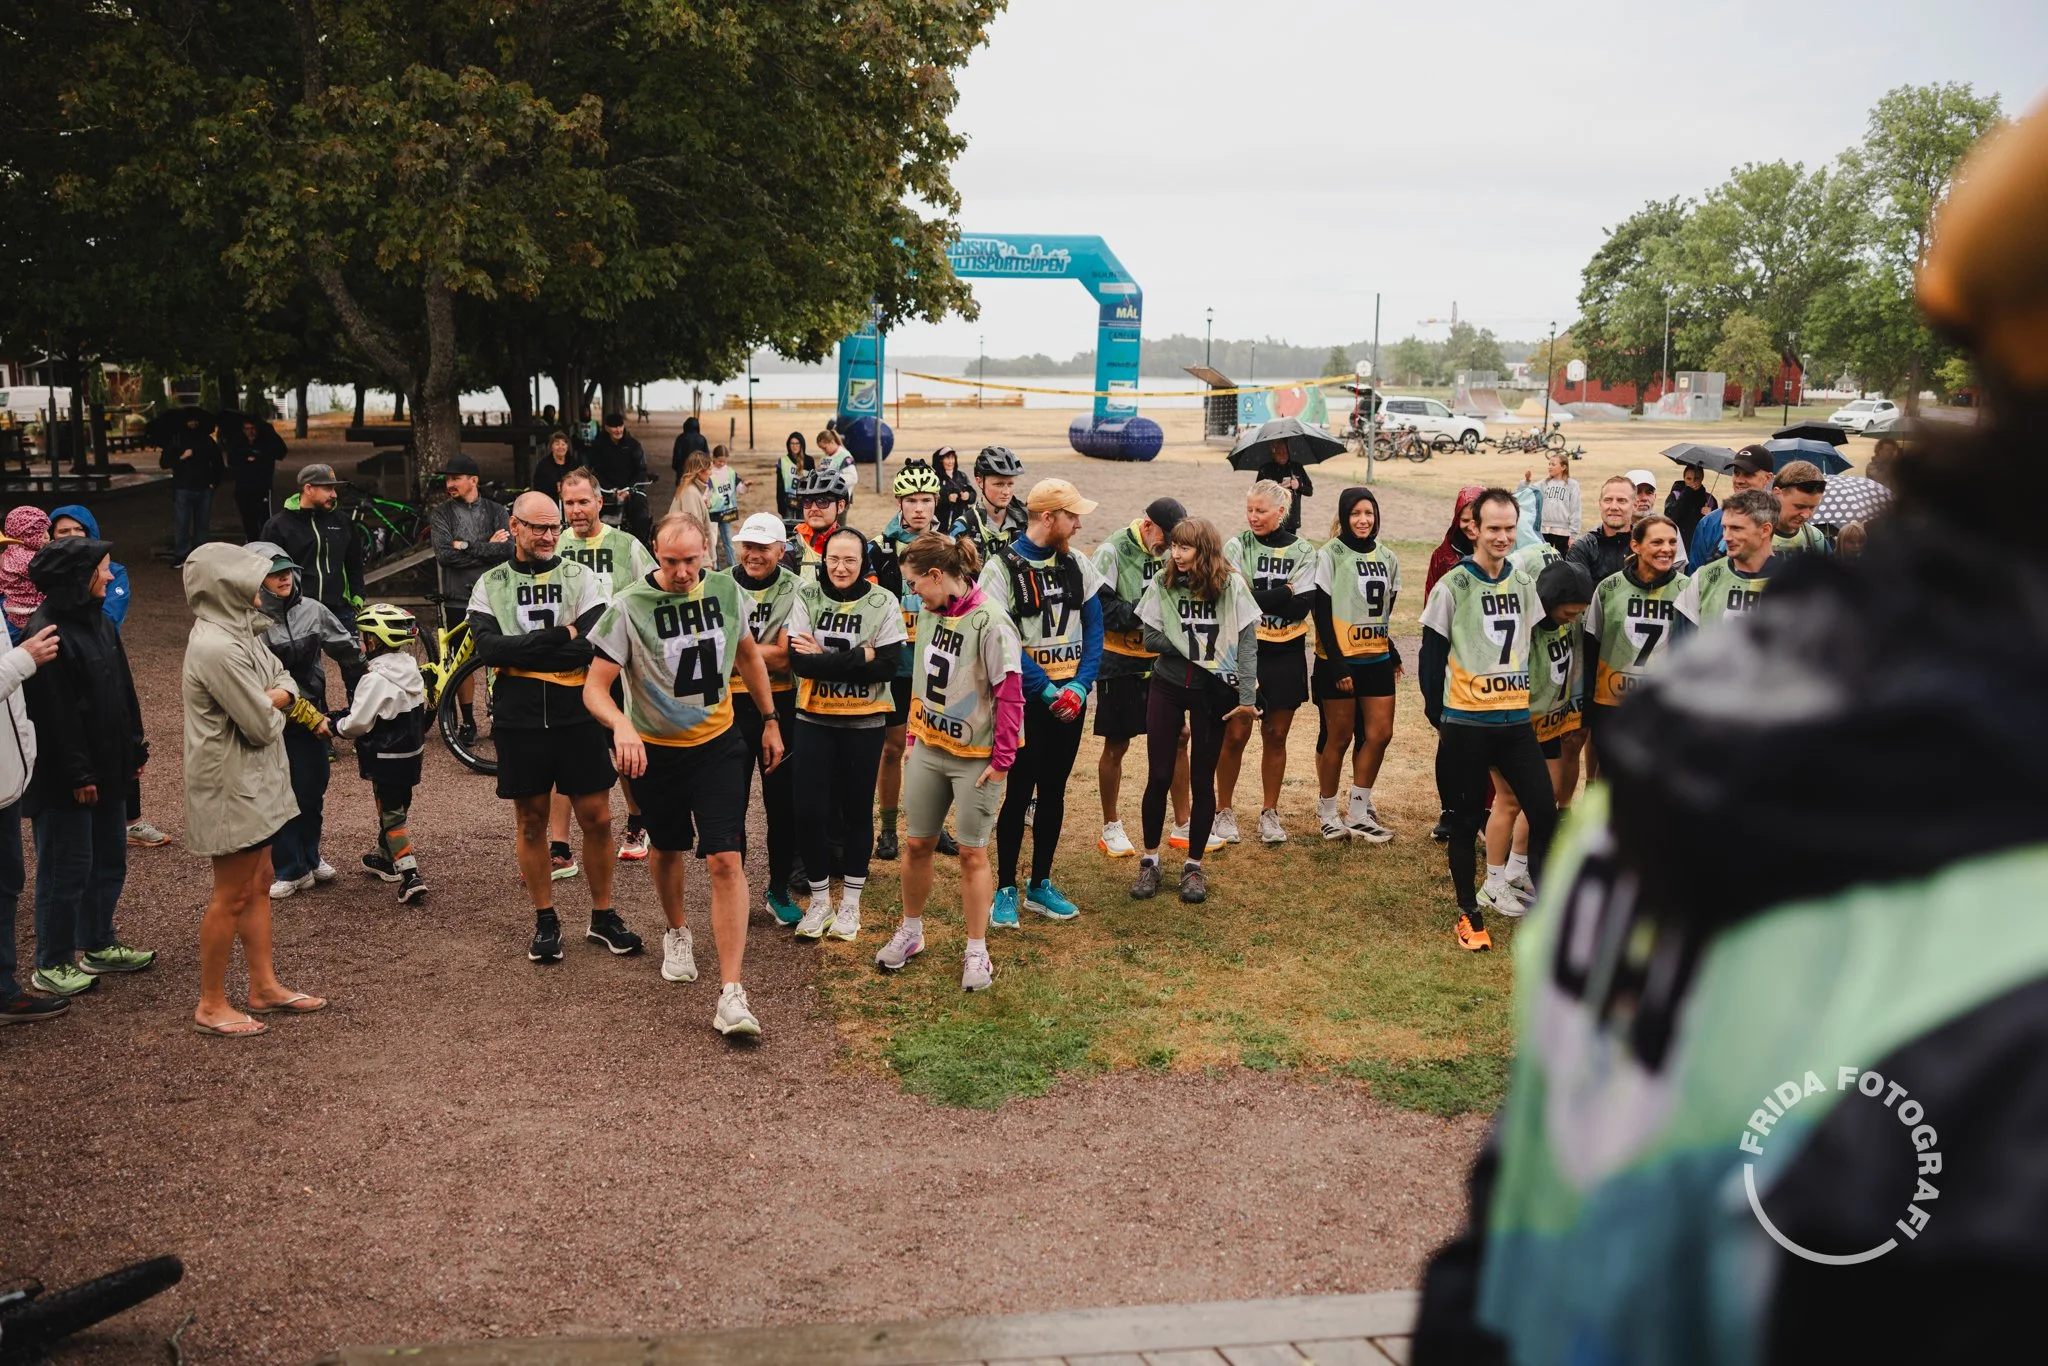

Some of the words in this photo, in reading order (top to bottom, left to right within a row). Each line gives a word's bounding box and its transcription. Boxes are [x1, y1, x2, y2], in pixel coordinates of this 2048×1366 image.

[1116, 305, 1138, 319] MÅL
[723, 494, 730, 506] 3
[1545, 486, 1566, 501] SOHO
[1257, 553, 1295, 575] ÖAR
[1356, 558, 1388, 577] ÖAR
[517, 582, 563, 606] ÖAR
[1178, 595, 1217, 619] ÖAR
[1366, 581, 1386, 617] 9
[1481, 591, 1521, 616] ÖAR
[1627, 594, 1674, 620] ÖAR
[1727, 585, 1761, 611] ÖA
[653, 596, 724, 640] ÖAR
[817, 607, 862, 634] ÖAR
[931, 619, 964, 656] ÖAR
[1181, 623, 1220, 661] 17
[1493, 619, 1516, 665] 7
[1634, 623, 1664, 667] 7
[674, 637, 724, 707] 4
[925, 653, 950, 706] 2
[1558, 656, 1570, 701] 7
[810, 682, 869, 698] JOKAB
[916, 705, 963, 739] JOKAB
